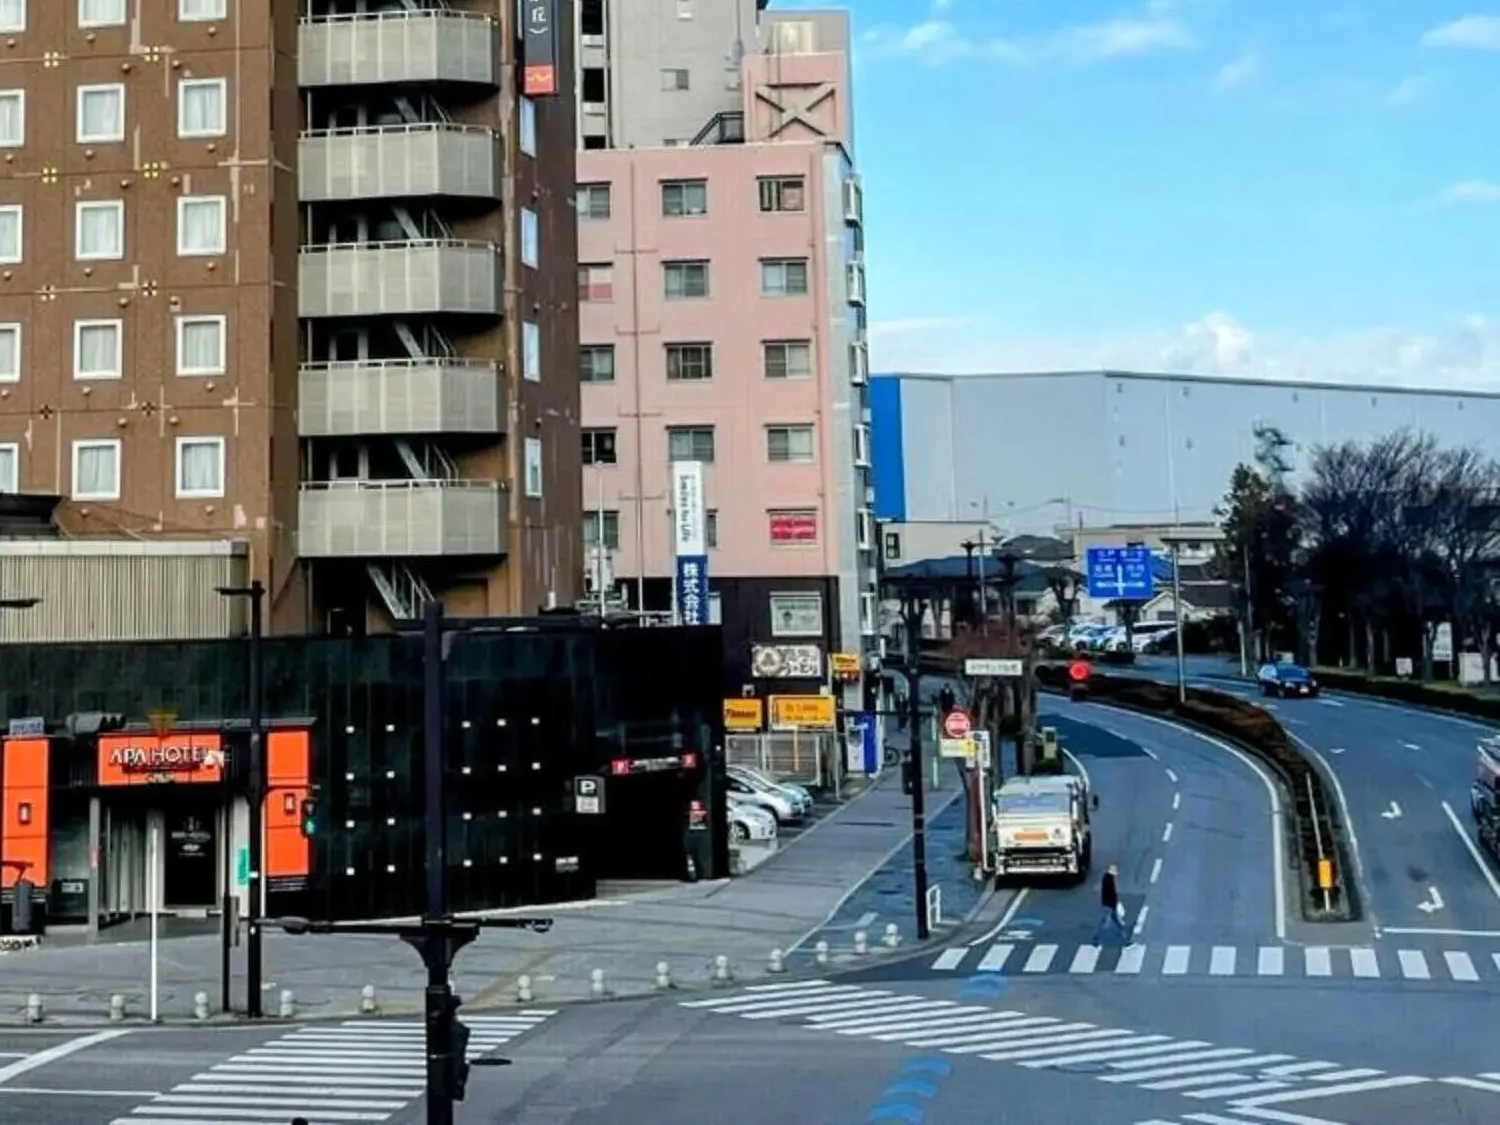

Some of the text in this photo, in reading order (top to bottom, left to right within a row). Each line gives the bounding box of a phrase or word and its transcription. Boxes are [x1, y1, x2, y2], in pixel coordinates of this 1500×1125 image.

[110, 746, 206, 764] APA HOTE
[580, 780, 596, 794] P
